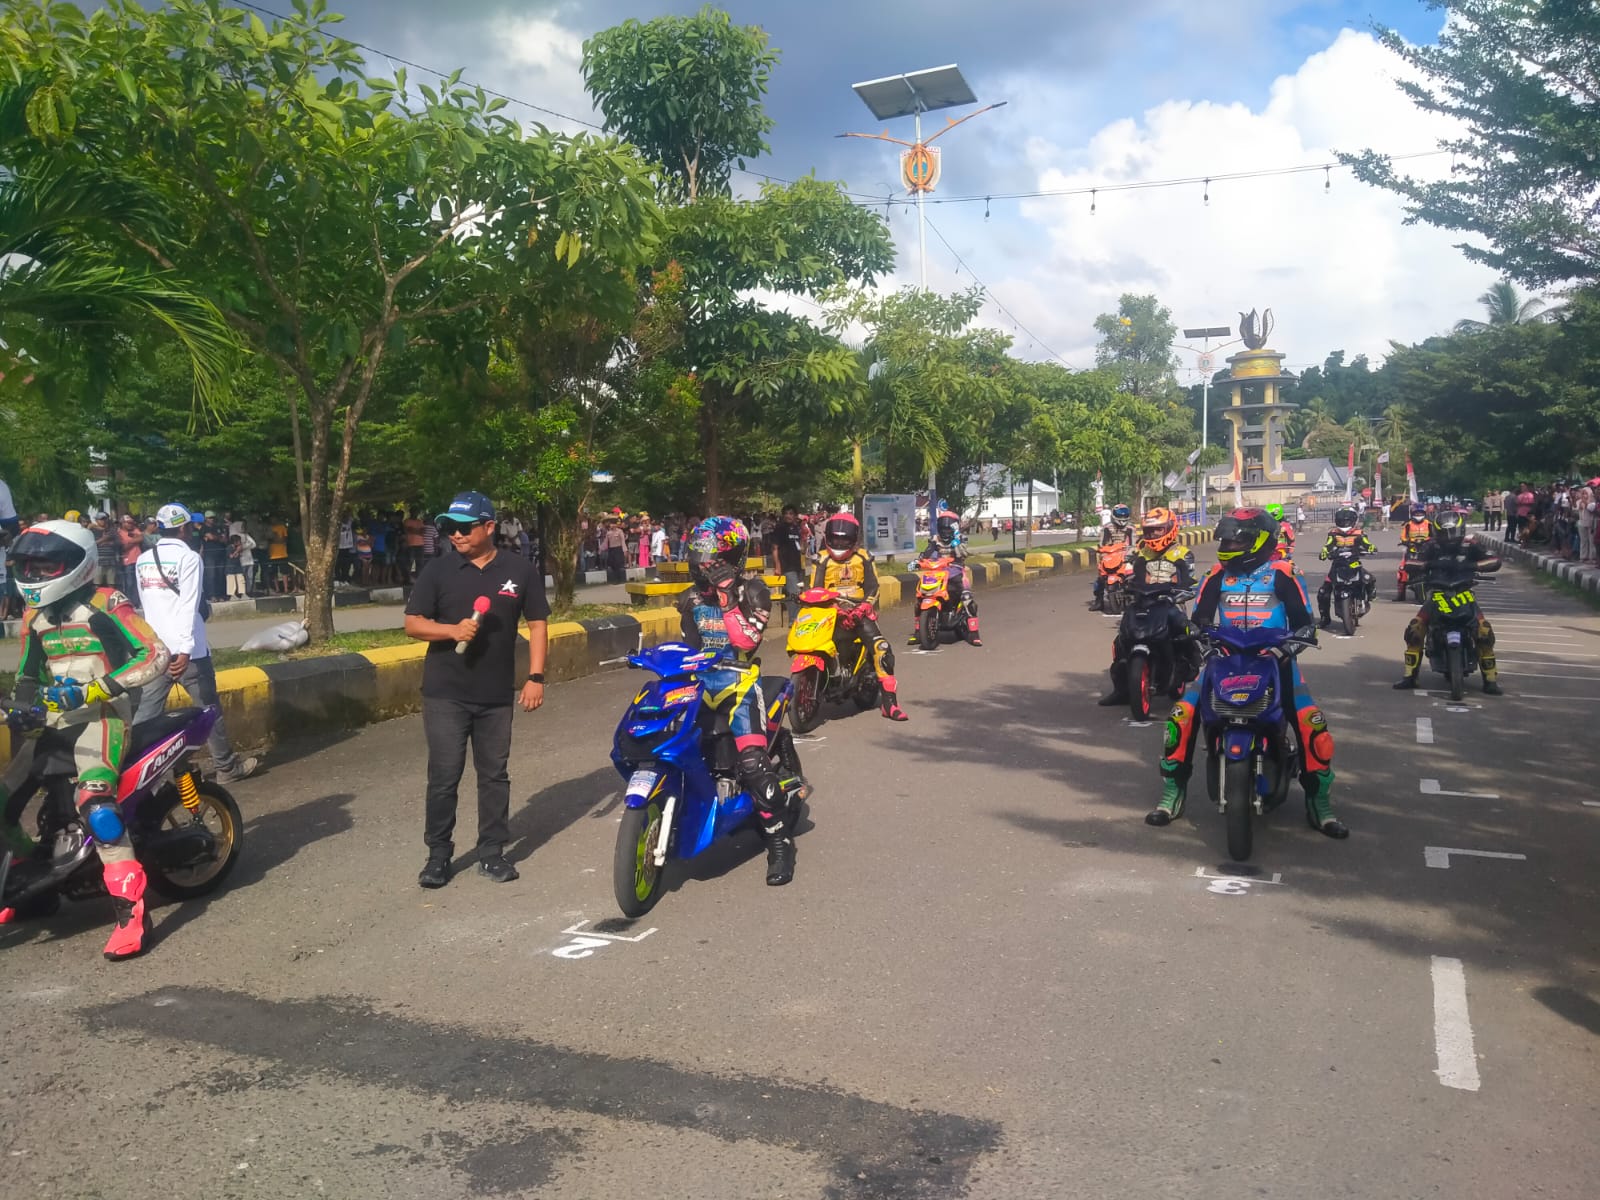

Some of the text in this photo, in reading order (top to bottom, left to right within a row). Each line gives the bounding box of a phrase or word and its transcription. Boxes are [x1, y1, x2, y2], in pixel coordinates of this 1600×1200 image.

[1225, 594, 1271, 603] RRS
[1206, 879, 1252, 895] 3
[551, 936, 612, 959] 2
